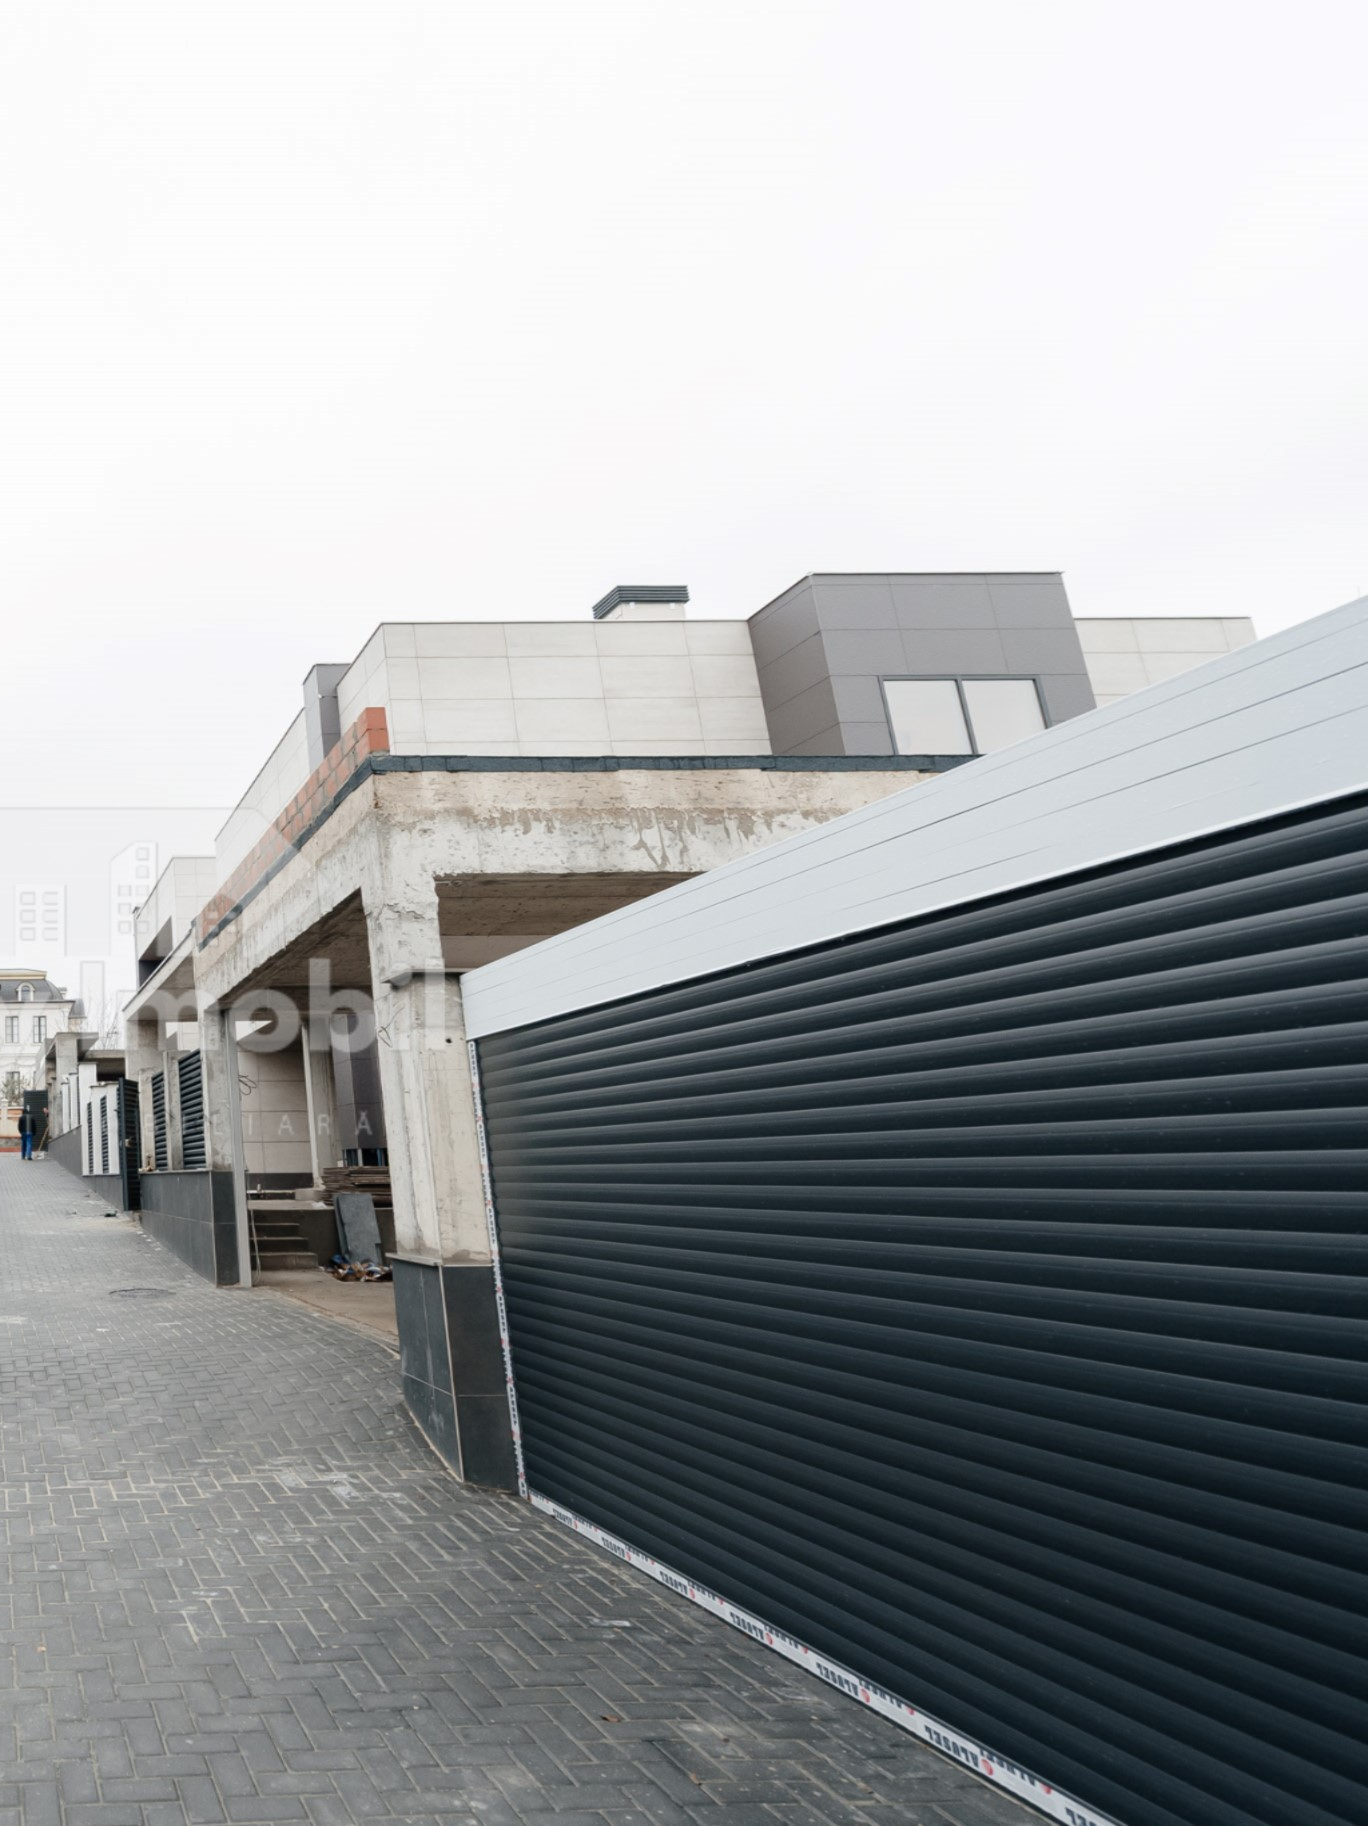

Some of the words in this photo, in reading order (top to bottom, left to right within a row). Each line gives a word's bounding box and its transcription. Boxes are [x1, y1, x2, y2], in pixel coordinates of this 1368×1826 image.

[729, 1611, 765, 1641] ALUSEL
[815, 1662, 860, 1697] ALUSEL
[924, 1725, 980, 1770] ALUSEL
